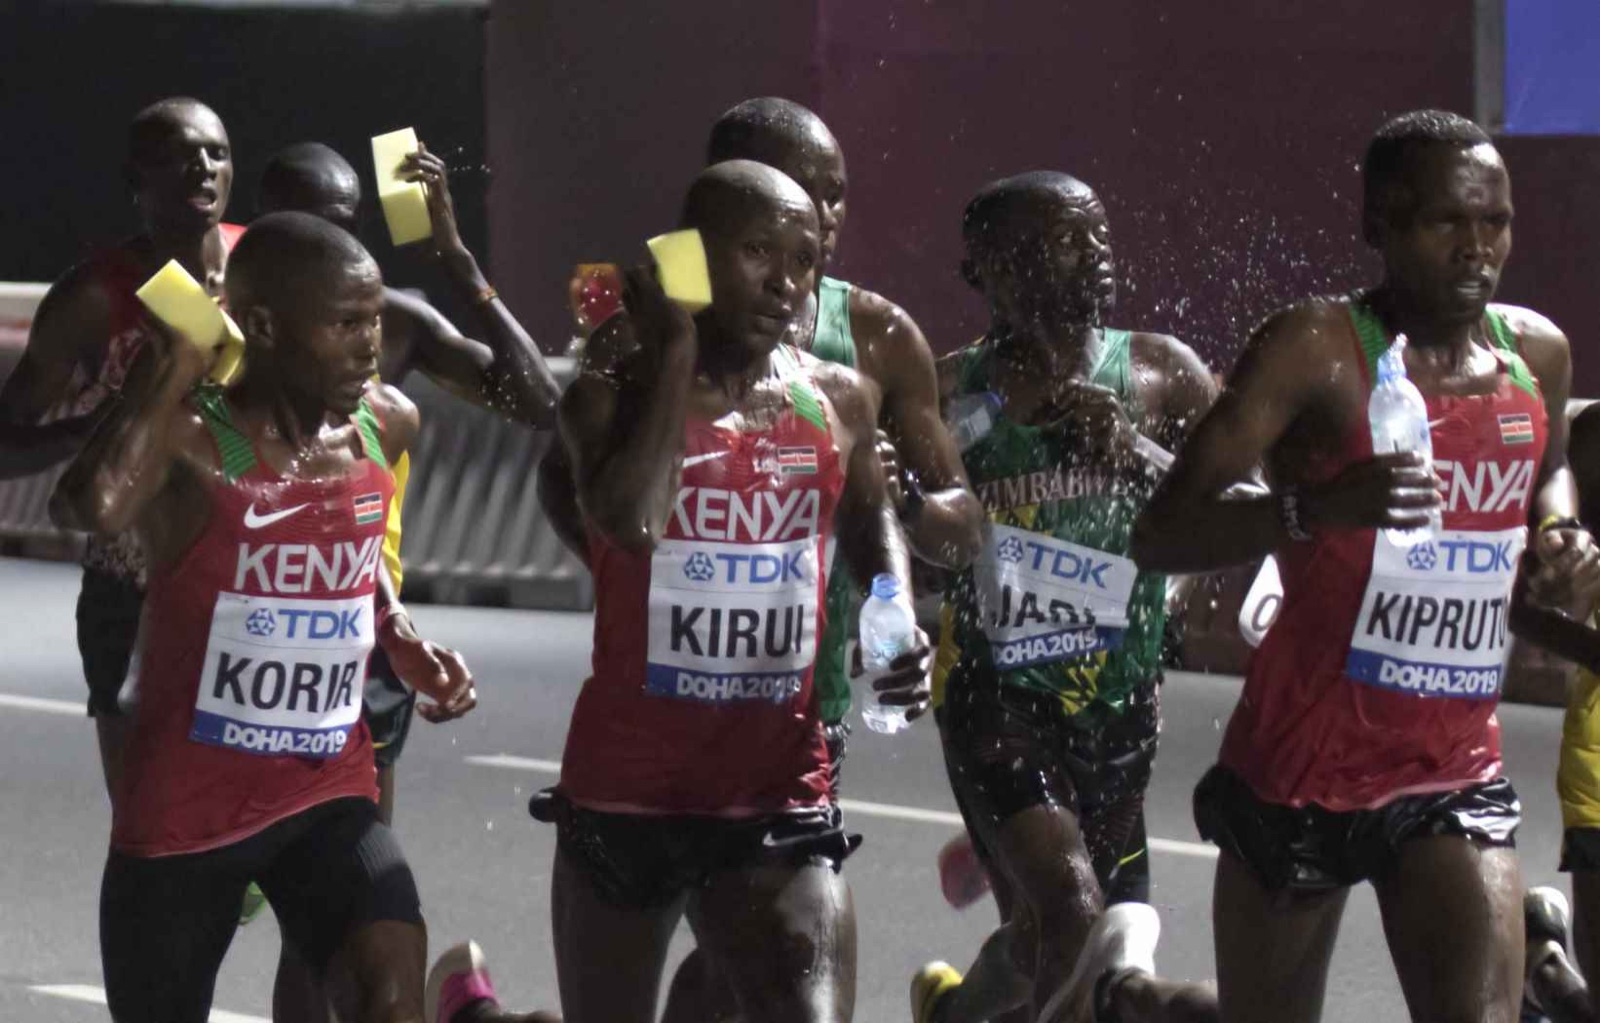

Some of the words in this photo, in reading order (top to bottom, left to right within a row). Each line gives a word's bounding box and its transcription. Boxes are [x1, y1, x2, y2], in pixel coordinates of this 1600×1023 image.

[975, 463, 1128, 504] ZIMBABW
[1433, 459, 1535, 513] ENYA
[673, 486, 821, 541] KENYA
[234, 535, 383, 593] KENYA
[716, 549, 804, 583] TDK
[1026, 541, 1113, 589] TDK
[1439, 540, 1512, 572] TDK
[277, 608, 362, 639] TDK
[670, 604, 804, 659] KIRUI
[212, 652, 359, 713] KORIR
[676, 671, 801, 700] DOHA2019
[1379, 660, 1498, 694] DOHA2019
[222, 722, 348, 753] DOHA2019
